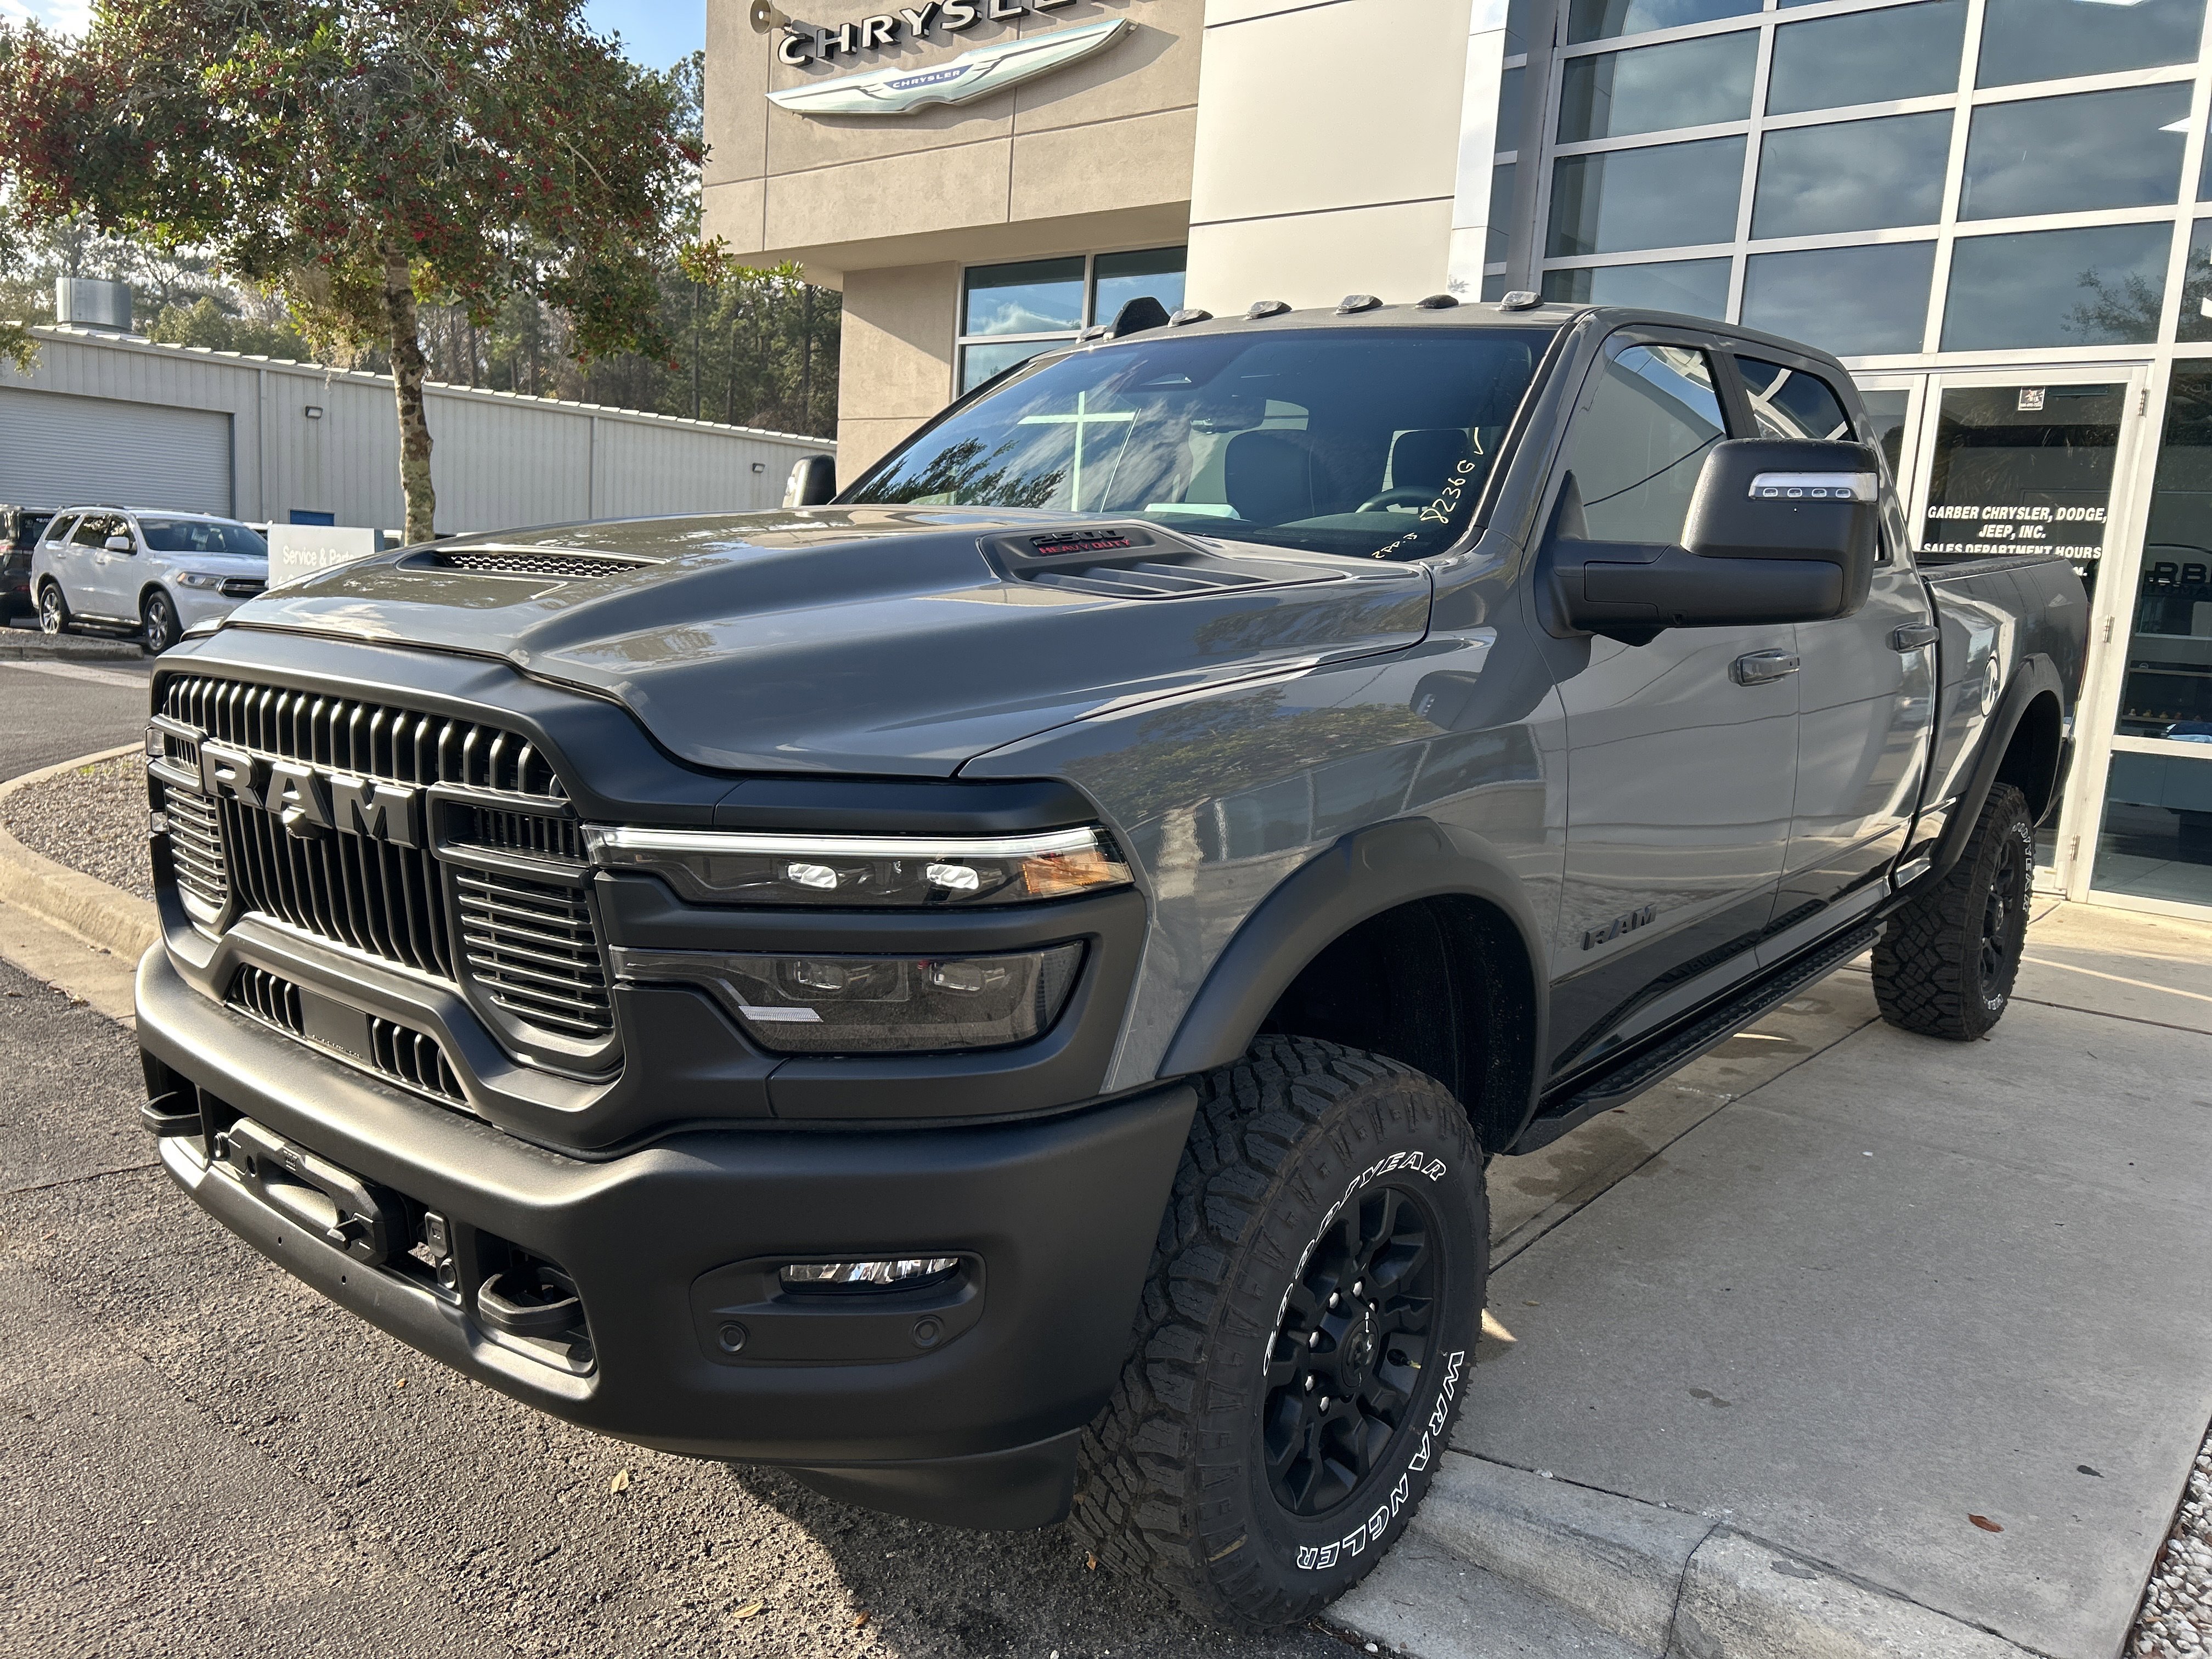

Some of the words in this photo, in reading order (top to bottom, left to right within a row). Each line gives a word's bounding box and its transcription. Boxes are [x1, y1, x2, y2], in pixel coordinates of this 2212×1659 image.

[777, 0, 1078, 66] CHRYSL
[892, 70, 961, 88] CHRYSLER
[1927, 506, 1979, 520] GARBER
[1982, 506, 2053, 523] CHRYSLER,
[2055, 507, 2108, 524] DODGE,
[1029, 530, 1125, 546] 2500
[1978, 524, 2017, 540] JEEP,
[2018, 525, 2047, 539] INC.
[283, 545, 317, 567] Service
[319, 548, 327, 567] &
[1039, 543, 1089, 555] HEAVY
[1091, 539, 1131, 549] DUTY
[2055, 546, 2102, 559] HOURS
[201, 741, 422, 850] RAM
[1580, 903, 1657, 951] RAM
[1263, 1151, 1447, 1376] GOODYEAR
[1296, 1350, 1465, 1570] WRANGLER
